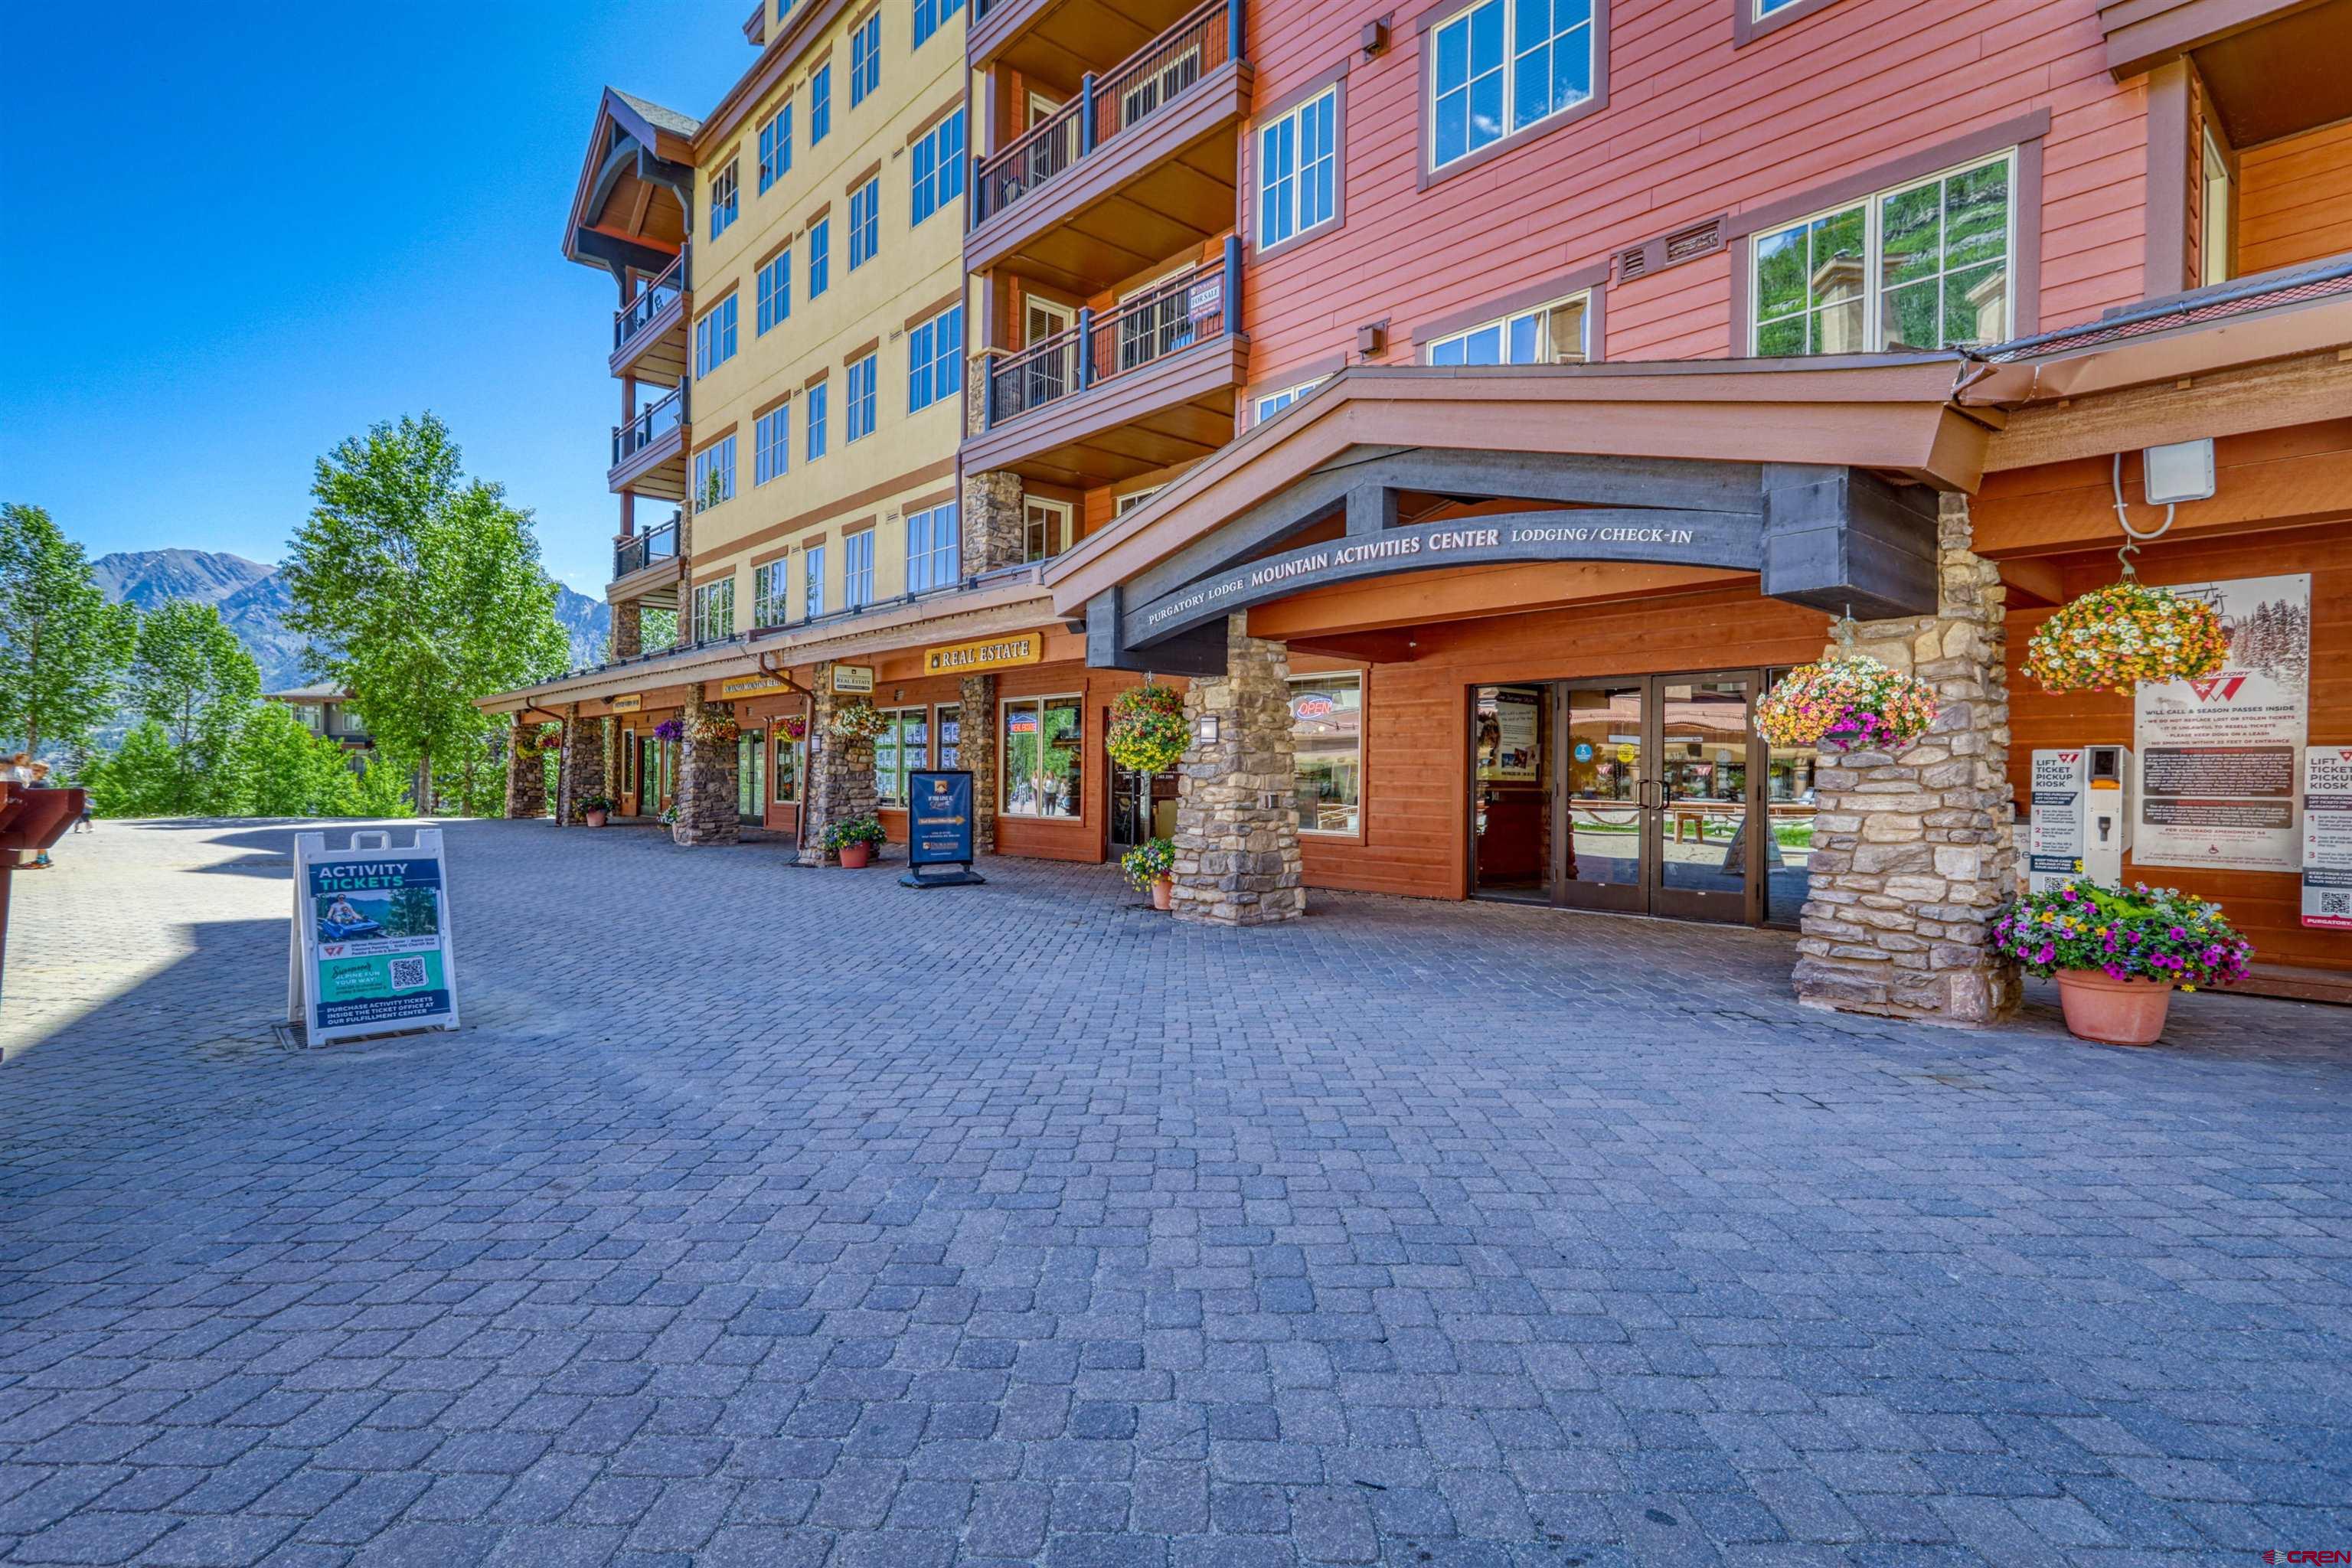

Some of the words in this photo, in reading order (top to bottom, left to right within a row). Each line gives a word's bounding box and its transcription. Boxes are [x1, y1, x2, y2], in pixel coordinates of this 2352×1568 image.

[1148, 593, 1206, 625] PURGATORY
[1208, 580, 1244, 599] LODGE
[1251, 552, 1328, 587] MOUNTAIN
[1334, 536, 1421, 566] ACTIVITIES
[1429, 529, 1500, 550] CENTER
[1511, 528, 1588, 542] LODGING
[1600, 528, 1693, 544] CHECK-IN
[942, 648, 976, 667] REAL
[979, 640, 1030, 662] ESTATE
[1298, 702, 1331, 714] OPEN
[318, 864, 408, 878] ACTIVITY
[319, 876, 404, 890] TICKETS
[327, 1004, 368, 1013] PURCHASE
[369, 1000, 403, 1008] ACTIVITY
[327, 1011, 354, 1019] INSIDE
[345, 1013, 397, 1023] FULFILLMENT
[398, 1008, 427, 1017] CENTER
